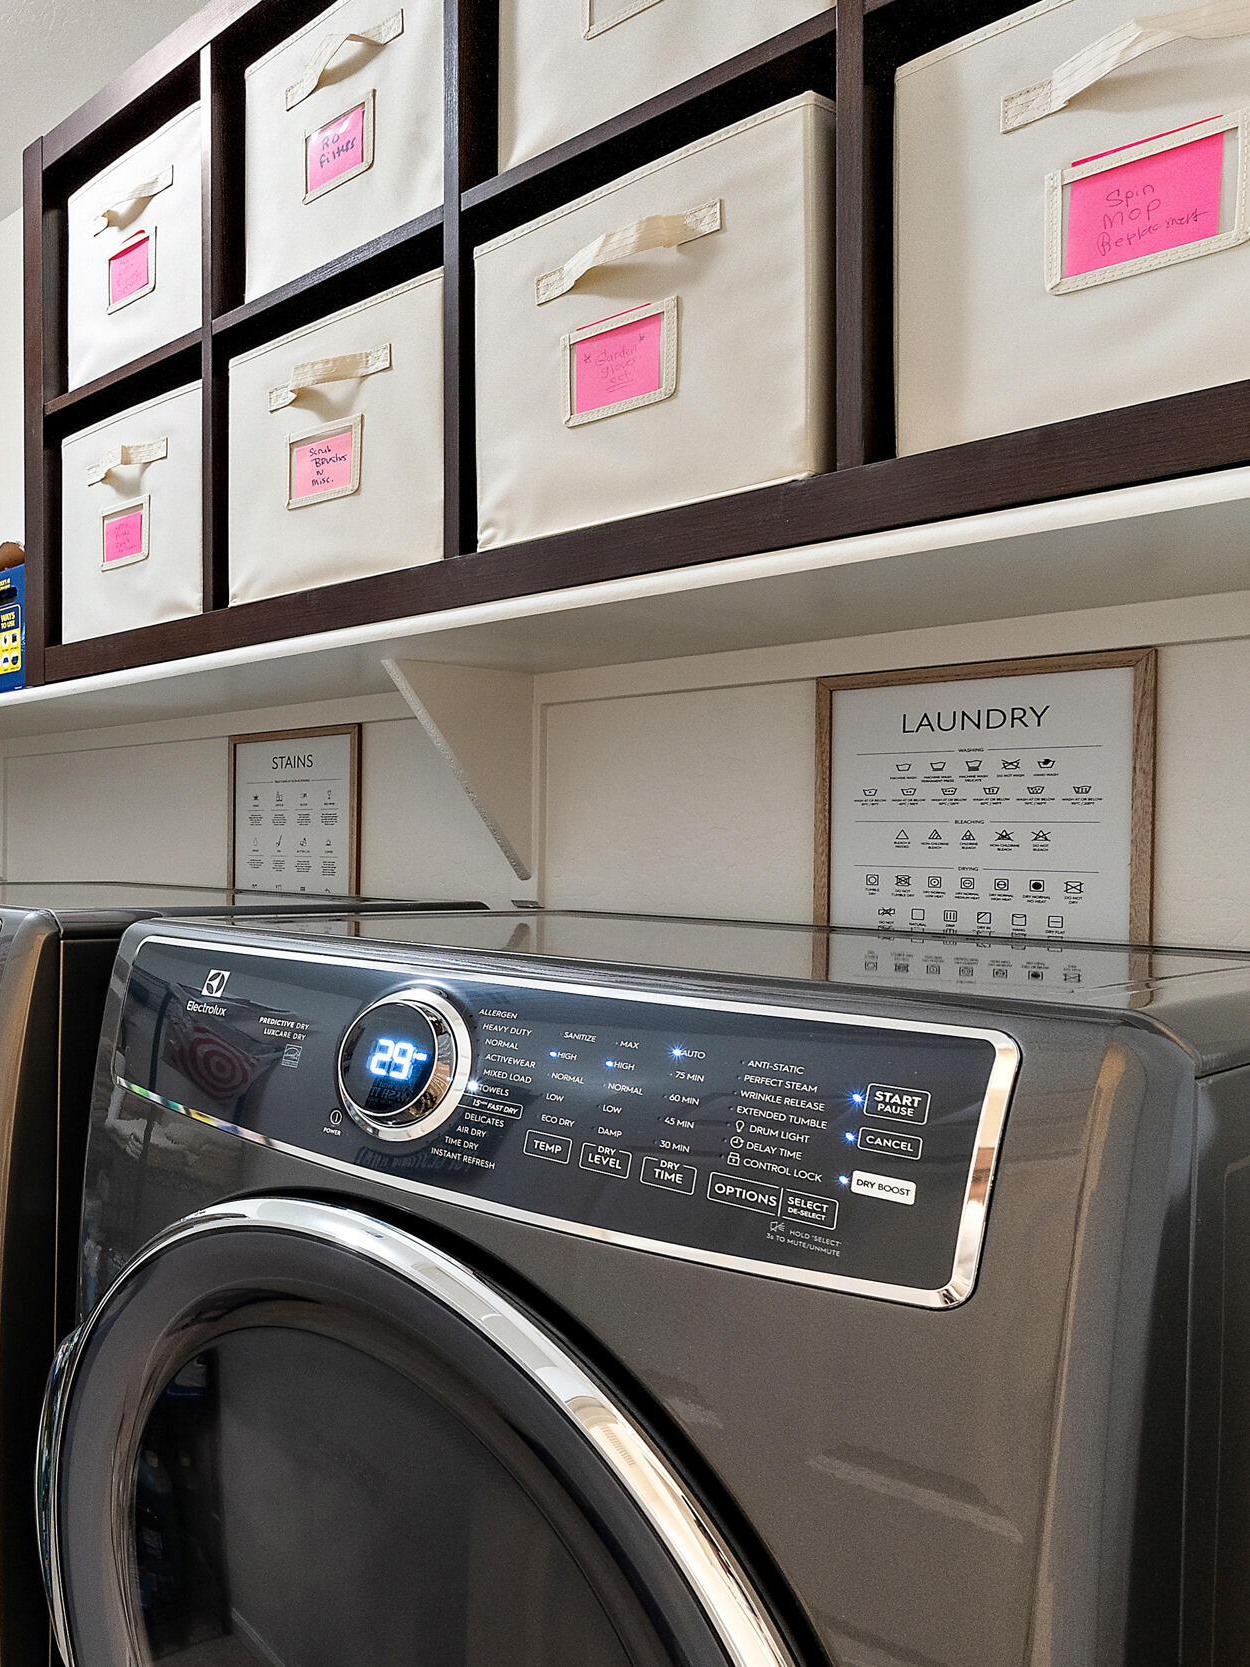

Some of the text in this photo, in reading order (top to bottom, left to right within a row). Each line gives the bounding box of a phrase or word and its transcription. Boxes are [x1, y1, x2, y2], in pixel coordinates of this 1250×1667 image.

[1105, 184, 1155, 208] Spin
[0, 611, 15, 622] WAYS
[901, 705, 1051, 734] LAUNDRY
[271, 754, 314, 770] STAINS
[186, 1000, 227, 1016] Electrolux
[478, 1008, 518, 1020] ALLERGEN
[258, 1016, 310, 1031] PREDICTIVE DRY
[482, 1023, 532, 1037] HEAVY DUTY
[263, 1027, 306, 1041] LUXCARE DRY
[563, 1031, 598, 1043] SANITIZE
[484, 1038, 519, 1050] NORMAL
[619, 1040, 640, 1050] MAX
[370, 1038, 414, 1080] 29
[484, 1053, 536, 1069] ACTIVEWEAR
[557, 1051, 578, 1061] HIGH
[682, 1049, 706, 1060] AUTO
[614, 1061, 635, 1071] HIGH
[747, 1060, 805, 1075] ANTI-STATIC
[482, 1068, 532, 1084] MIXED LOAD
[551, 1072, 585, 1084] NORMAL
[674, 1070, 705, 1082] 75 MIN
[478, 1084, 510, 1097] TOWELS
[607, 1083, 644, 1096] NORMAL
[743, 1074, 818, 1093] PERFECT STEAM
[546, 1093, 565, 1102] LOW
[669, 1093, 700, 1106] 60 MIN
[740, 1089, 826, 1112] WRINKLE RELEASE
[874, 1090, 922, 1107] START
[487, 1102, 503, 1112] FAST
[502, 1105, 518, 1115] DRY
[602, 1104, 623, 1114] LOW
[877, 1104, 915, 1117] PAUSE
[464, 1112, 504, 1128] DELICATES
[541, 1114, 575, 1128] ECO DRY
[664, 1117, 695, 1129] 45 MIN
[736, 1105, 828, 1130] EXTENDED TUMBLE
[322, 1127, 342, 1137] POWER
[456, 1125, 487, 1138] AIR DRY
[597, 1126, 623, 1138] DAMP
[749, 1124, 810, 1144] DRUM LIGHT
[444, 1136, 479, 1150] TIME DRY
[533, 1139, 563, 1154] TEMP
[597, 1144, 617, 1155] DRY
[659, 1140, 690, 1153] 30 MIN
[865, 1135, 914, 1153] CANCEL
[746, 1141, 803, 1161] DELAY TIME
[431, 1147, 496, 1170] INSTANT REFRESH
[588, 1153, 623, 1170] LEVEL
[659, 1159, 680, 1170] DRY
[653, 1168, 684, 1184] TIME
[743, 1158, 823, 1183] CONTROL LOCK
[714, 1182, 778, 1208] OPTIONS
[856, 1178, 911, 1198] DRY BOOST
[787, 1196, 829, 1213] SELECT
[787, 1207, 826, 1222] DE-SELECT
[789, 1229, 810, 1240] HOLD
[776, 1234, 786, 1243] TO
[787, 1238, 841, 1257] MUTE/UNMUTE
